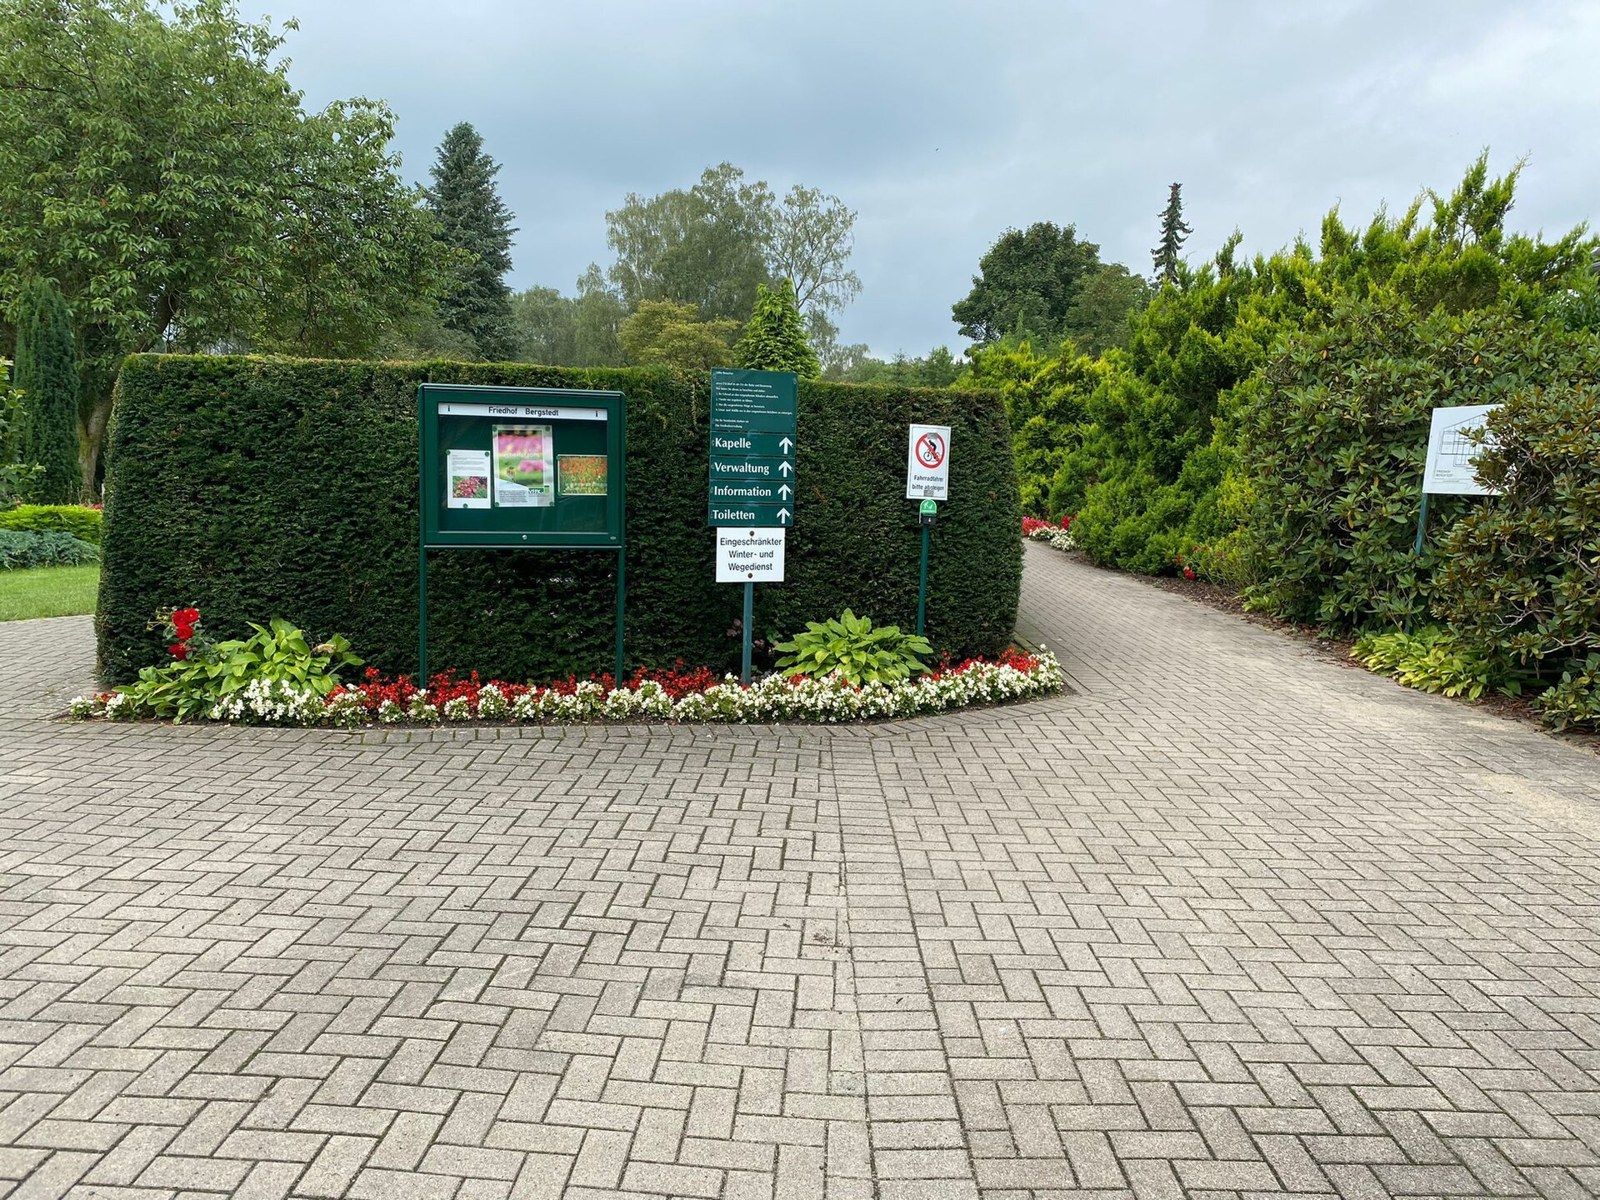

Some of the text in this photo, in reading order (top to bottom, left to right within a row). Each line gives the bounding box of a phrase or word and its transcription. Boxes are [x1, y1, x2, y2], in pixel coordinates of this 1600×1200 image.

[488, 406, 518, 415] Friedhof
[525, 407, 559, 417] Bergstedt
[715, 437, 752, 450] Kapelle
[714, 462, 770, 475] Verwaltung
[714, 486, 772, 497] Information
[712, 509, 755, 520] Toiletten
[720, 537, 782, 548] Eingeschränkter
[728, 550, 774, 559] Winter- und
[728, 562, 773, 571] Wegedienst
